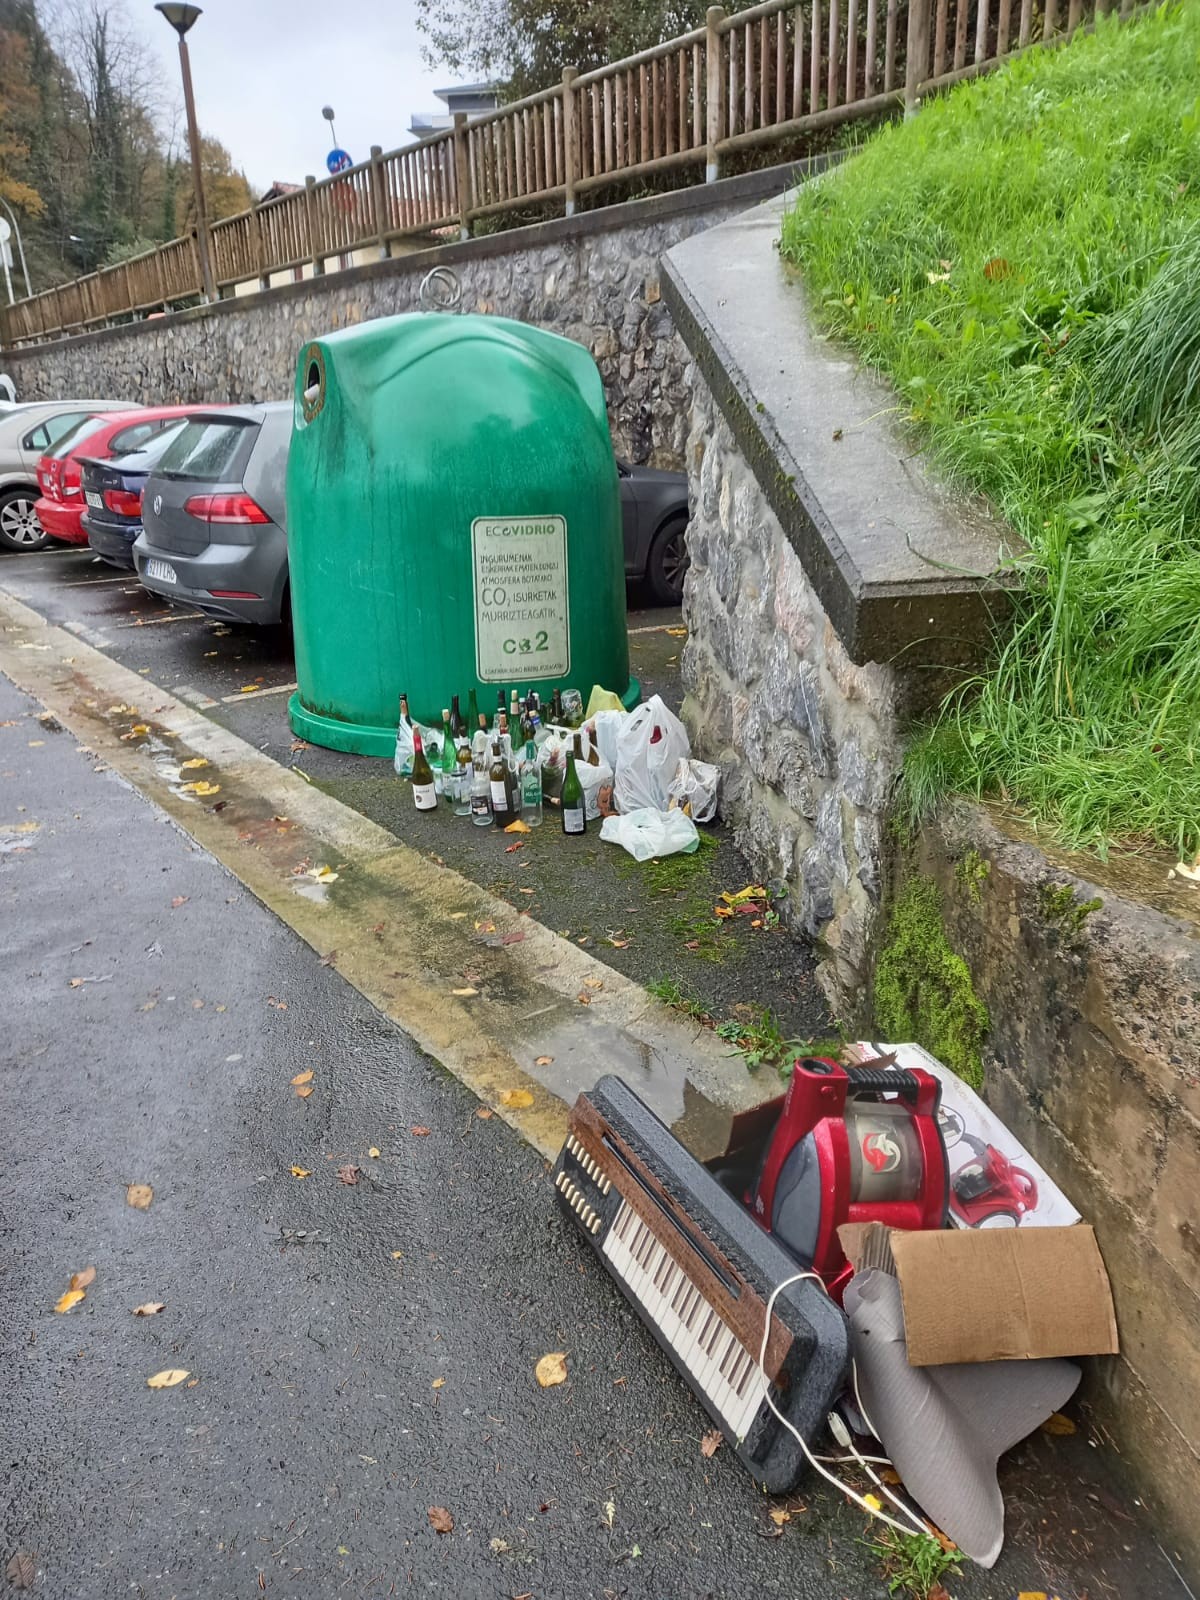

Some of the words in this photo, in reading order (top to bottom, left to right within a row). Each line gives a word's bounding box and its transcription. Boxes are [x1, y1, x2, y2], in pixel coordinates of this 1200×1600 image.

[485, 524, 555, 537] ECOVIDRIO
[513, 589, 557, 603] ISURKETAK
[481, 607, 556, 624] MURRIZTEAGATIK
